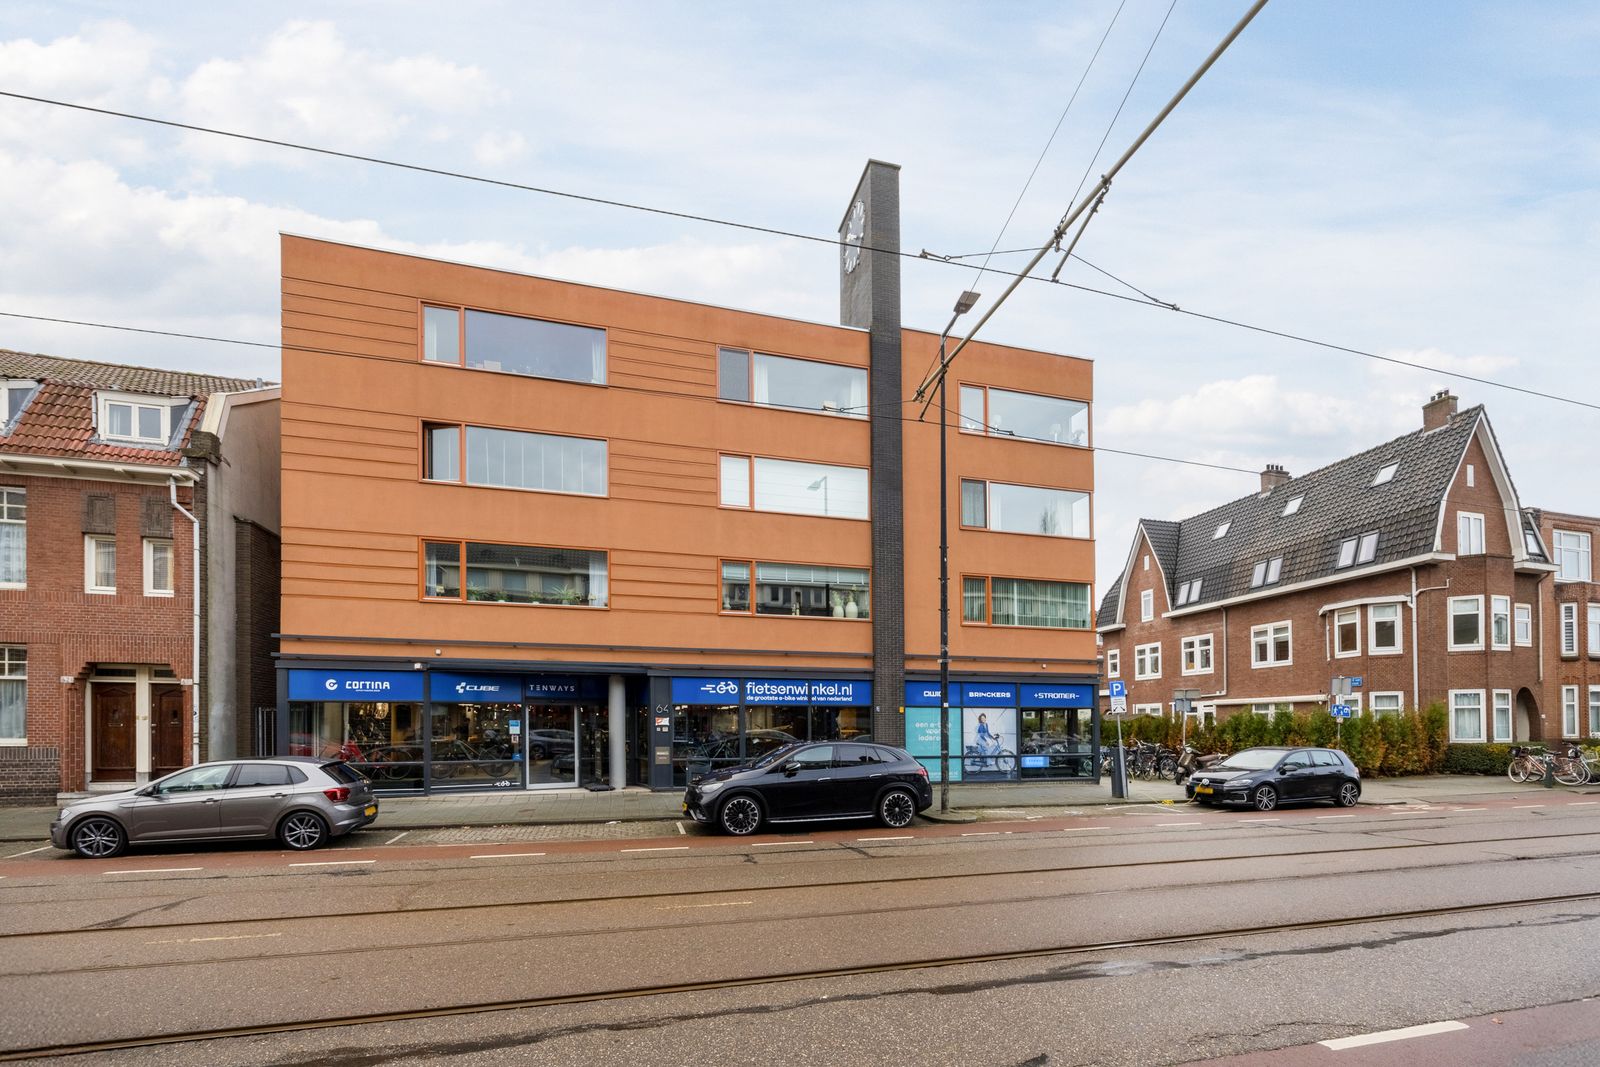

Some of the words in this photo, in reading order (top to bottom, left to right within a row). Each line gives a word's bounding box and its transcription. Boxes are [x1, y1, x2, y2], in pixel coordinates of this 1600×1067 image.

[345, 680, 390, 690] CORTINA
[530, 684, 575, 692] TENWAYS
[746, 682, 852, 696] fietsenwinkel.nl
[1112, 684, 1122, 696] P
[656, 704, 668, 714] 64
